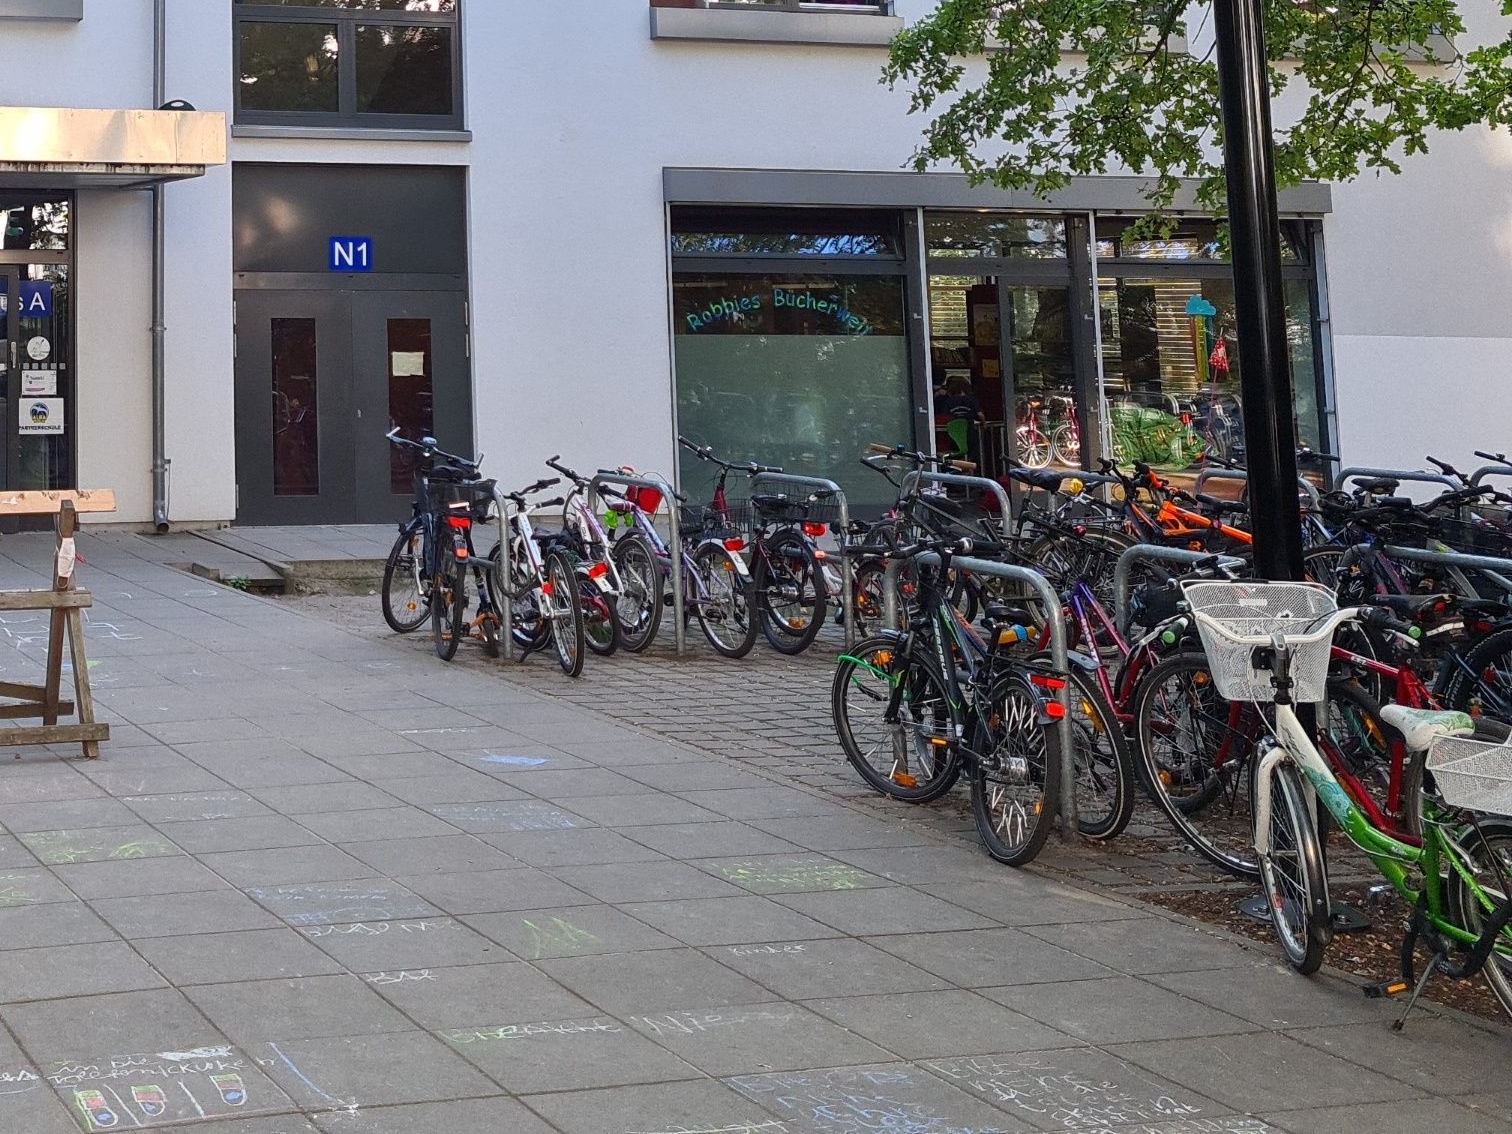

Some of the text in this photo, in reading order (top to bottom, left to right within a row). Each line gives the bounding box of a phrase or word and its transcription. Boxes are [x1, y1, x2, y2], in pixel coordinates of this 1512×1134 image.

[334, 242, 367, 266] N1
[29, 291, 46, 311] A
[687, 294, 761, 332] Robbies
